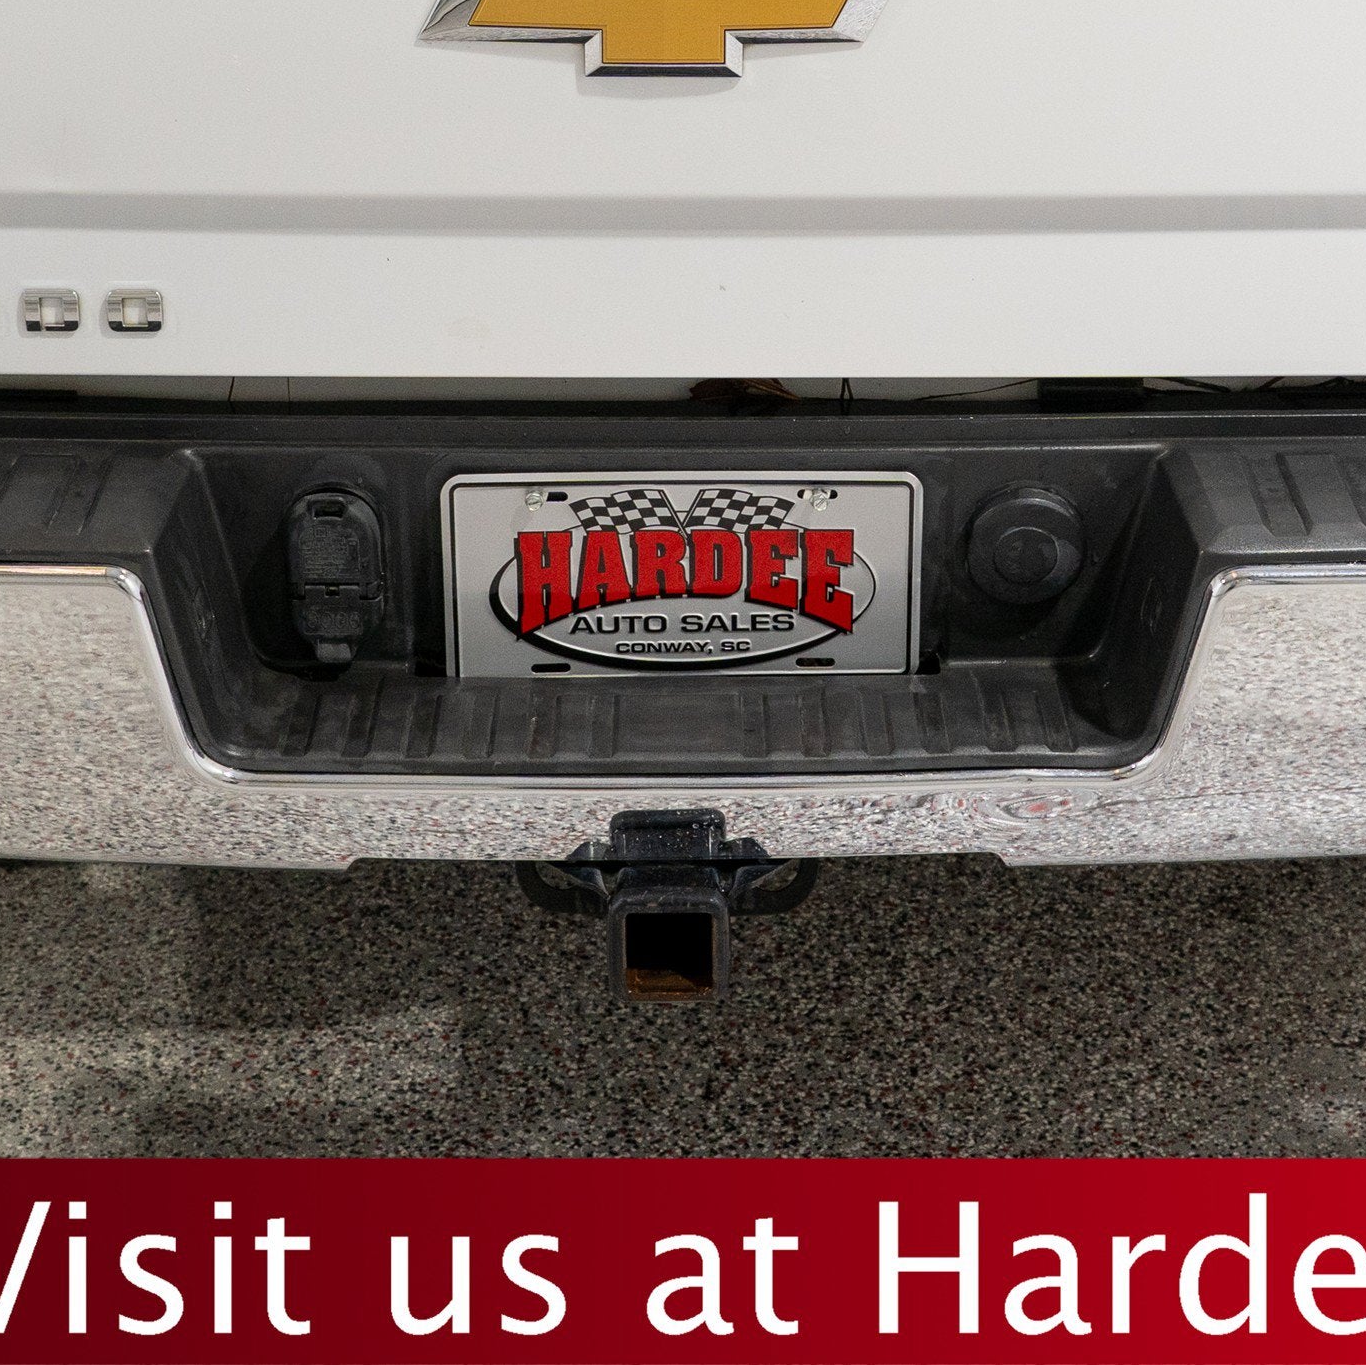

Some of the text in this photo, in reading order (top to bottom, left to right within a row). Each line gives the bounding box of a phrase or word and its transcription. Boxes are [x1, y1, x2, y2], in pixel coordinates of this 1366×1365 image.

[515, 528, 856, 639] HARDEE
[568, 612, 795, 634] AUTO SALES
[615, 639, 751, 655] CONWAY, SC
